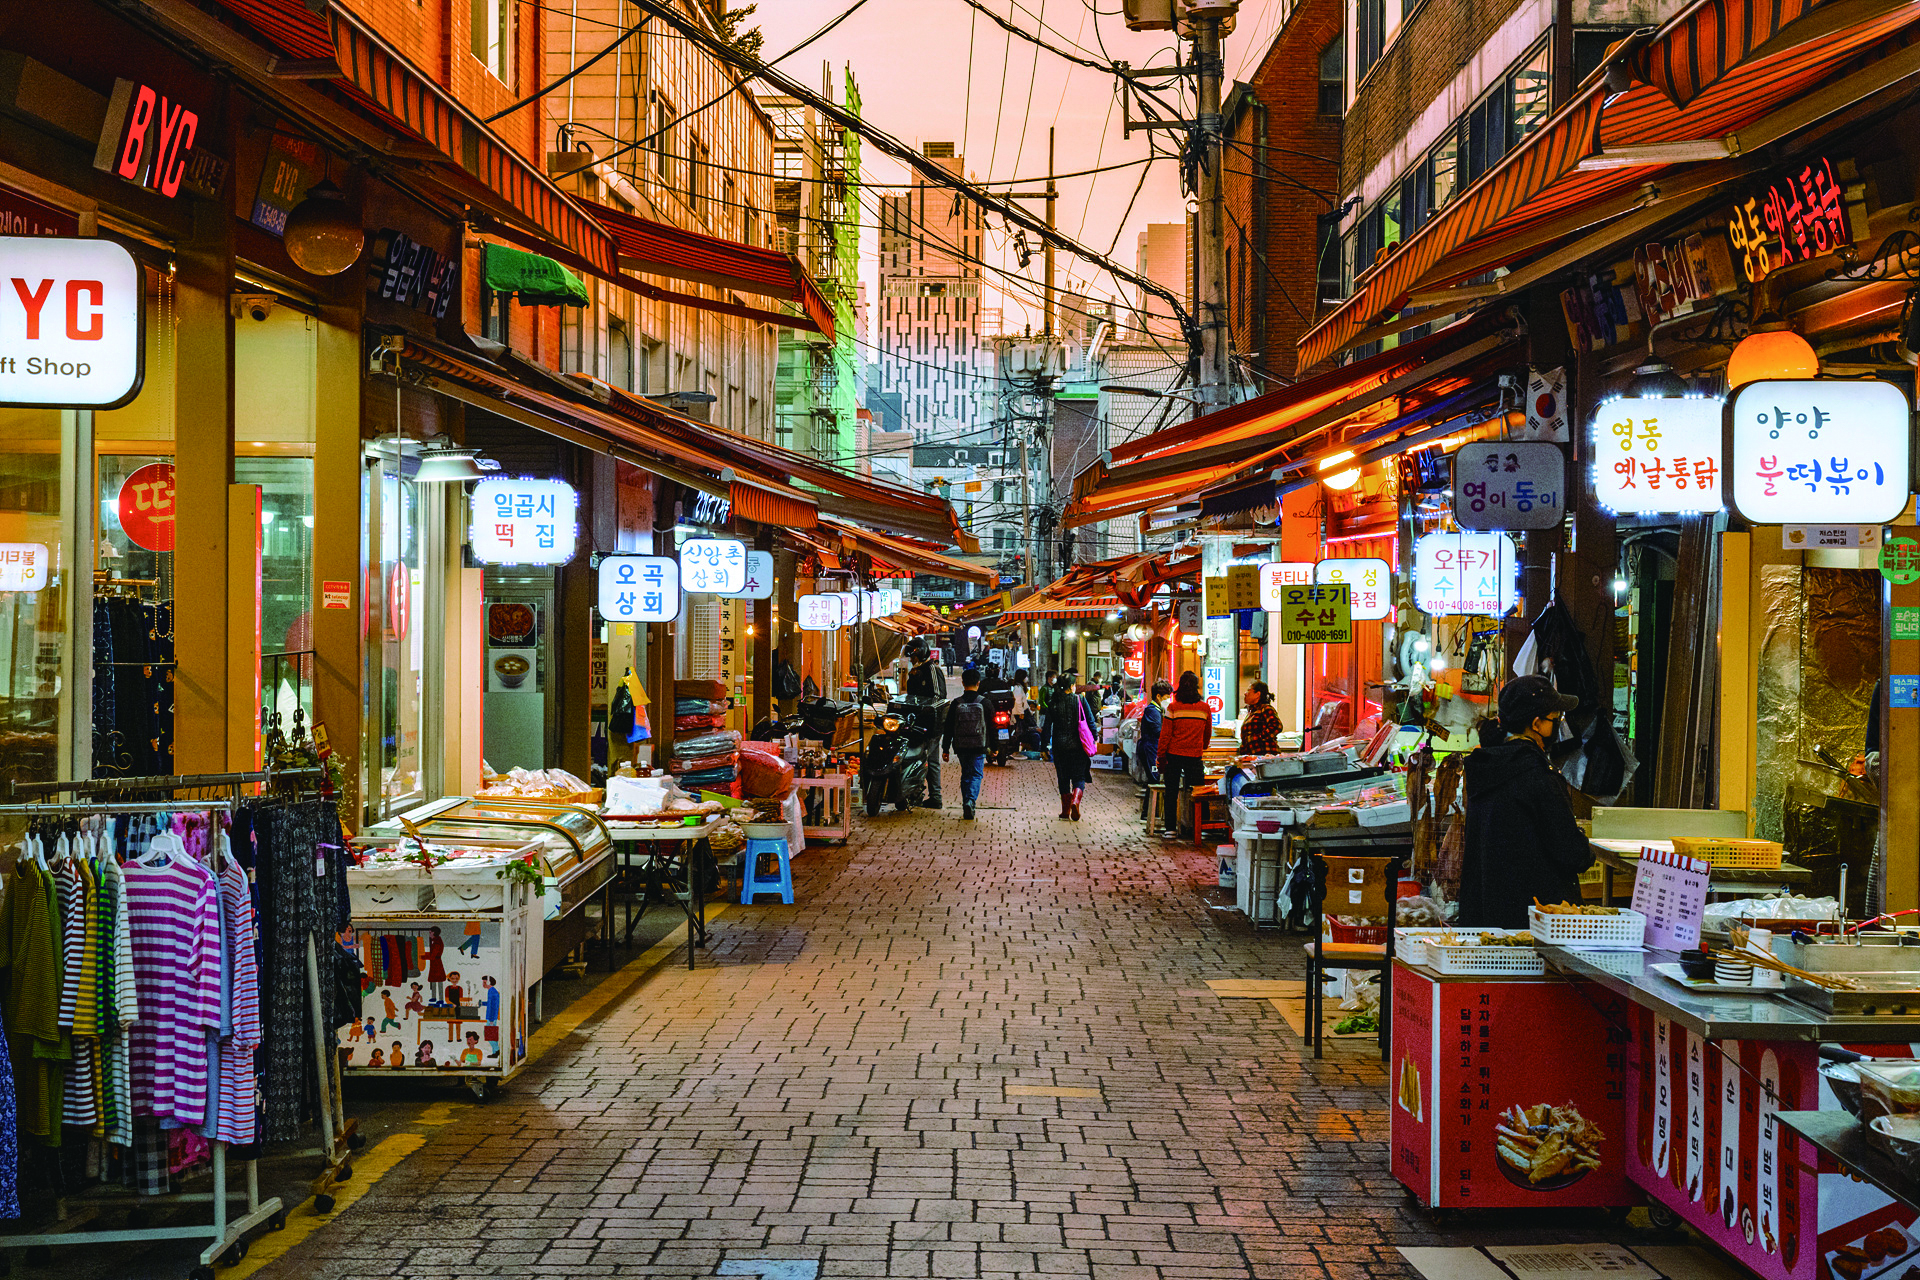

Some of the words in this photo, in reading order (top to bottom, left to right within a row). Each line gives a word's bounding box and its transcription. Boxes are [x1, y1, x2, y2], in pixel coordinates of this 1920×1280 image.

[119, 84, 198, 198] BYC
[274, 161, 299, 200] BYC
[1730, 196, 1770, 283] 영동
[1763, 157, 1846, 267] 옛날통닭
[0, 278, 103, 341] YC
[26, 357, 92, 378] Shop
[1612, 417, 1663, 452] 영동
[1757, 406, 1832, 440] 양양
[1613, 456, 1719, 491] 옛날통닭
[1756, 454, 1885, 496] 불떡볶이
[494, 493, 556, 519] 일곱시
[683, 544, 742, 566] 신앙촌
[1434, 549, 1497, 570] 오뚜기
[615, 563, 664, 588] 오곡
[691, 568, 729, 588] 상회
[1271, 570, 1309, 586] 불티나
[1434, 575, 1497, 598] 수산
[615, 591, 663, 616] 상회
[808, 600, 830, 611] 수미
[1287, 587, 1346, 605] 오뚜기
[1351, 591, 1377, 608] 육점
[808, 613, 830, 625] 상회
[1295, 608, 1337, 627] 수산
[1287, 629, 1347, 640] 010-4008-1691
[1894, 678, 1919, 686] 마스크는
[1460, 1008, 1472, 1068] 담백하고
[1605, 1000, 1623, 1100] 수제튀김
[1479, 1066, 1490, 1111] 튀겨서
[1658, 1022, 1668, 1139] 부산오뎅
[1460, 1082, 1472, 1126] 소화가
[1690, 1041, 1700, 1162] 소떡소떡
[1725, 1078, 1735, 1172] 순대
[1460, 1139, 1472, 1153] 잘
[1460, 1168, 1472, 1197] 되는
